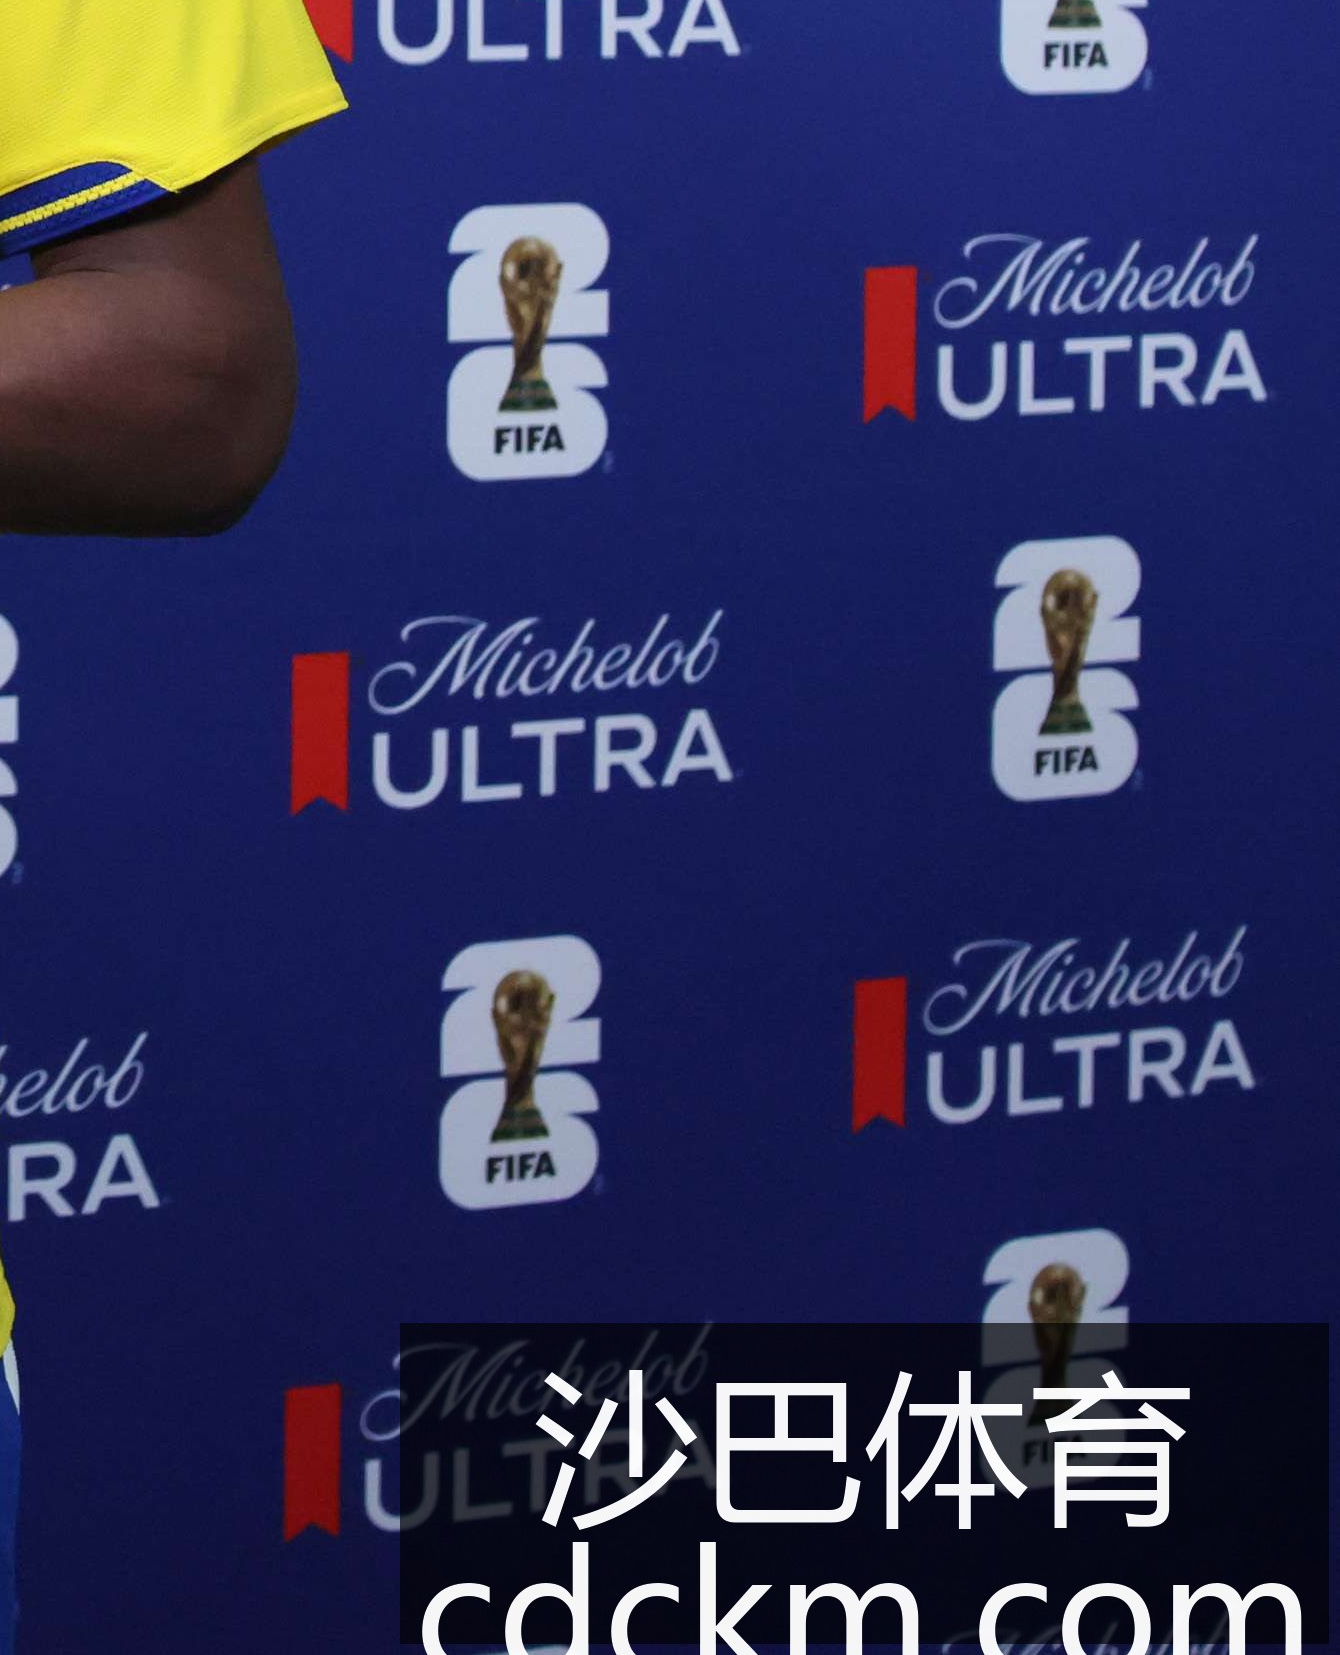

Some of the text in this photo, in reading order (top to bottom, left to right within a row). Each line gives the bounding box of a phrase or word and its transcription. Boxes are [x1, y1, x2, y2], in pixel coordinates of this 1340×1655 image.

[1044, 42, 1108, 68] FIFA
[933, 233, 1259, 336] Michelob
[938, 330, 1267, 420] ULTRA
[495, 425, 564, 454] FIFA
[368, 608, 724, 721] Michelob
[372, 704, 733, 809] ULTRA
[1035, 747, 1098, 775] FIFA
[923, 925, 1247, 1038] Michelob
[927, 1014, 1255, 1124] ULTRA
[486, 1151, 555, 1183] FIFA
